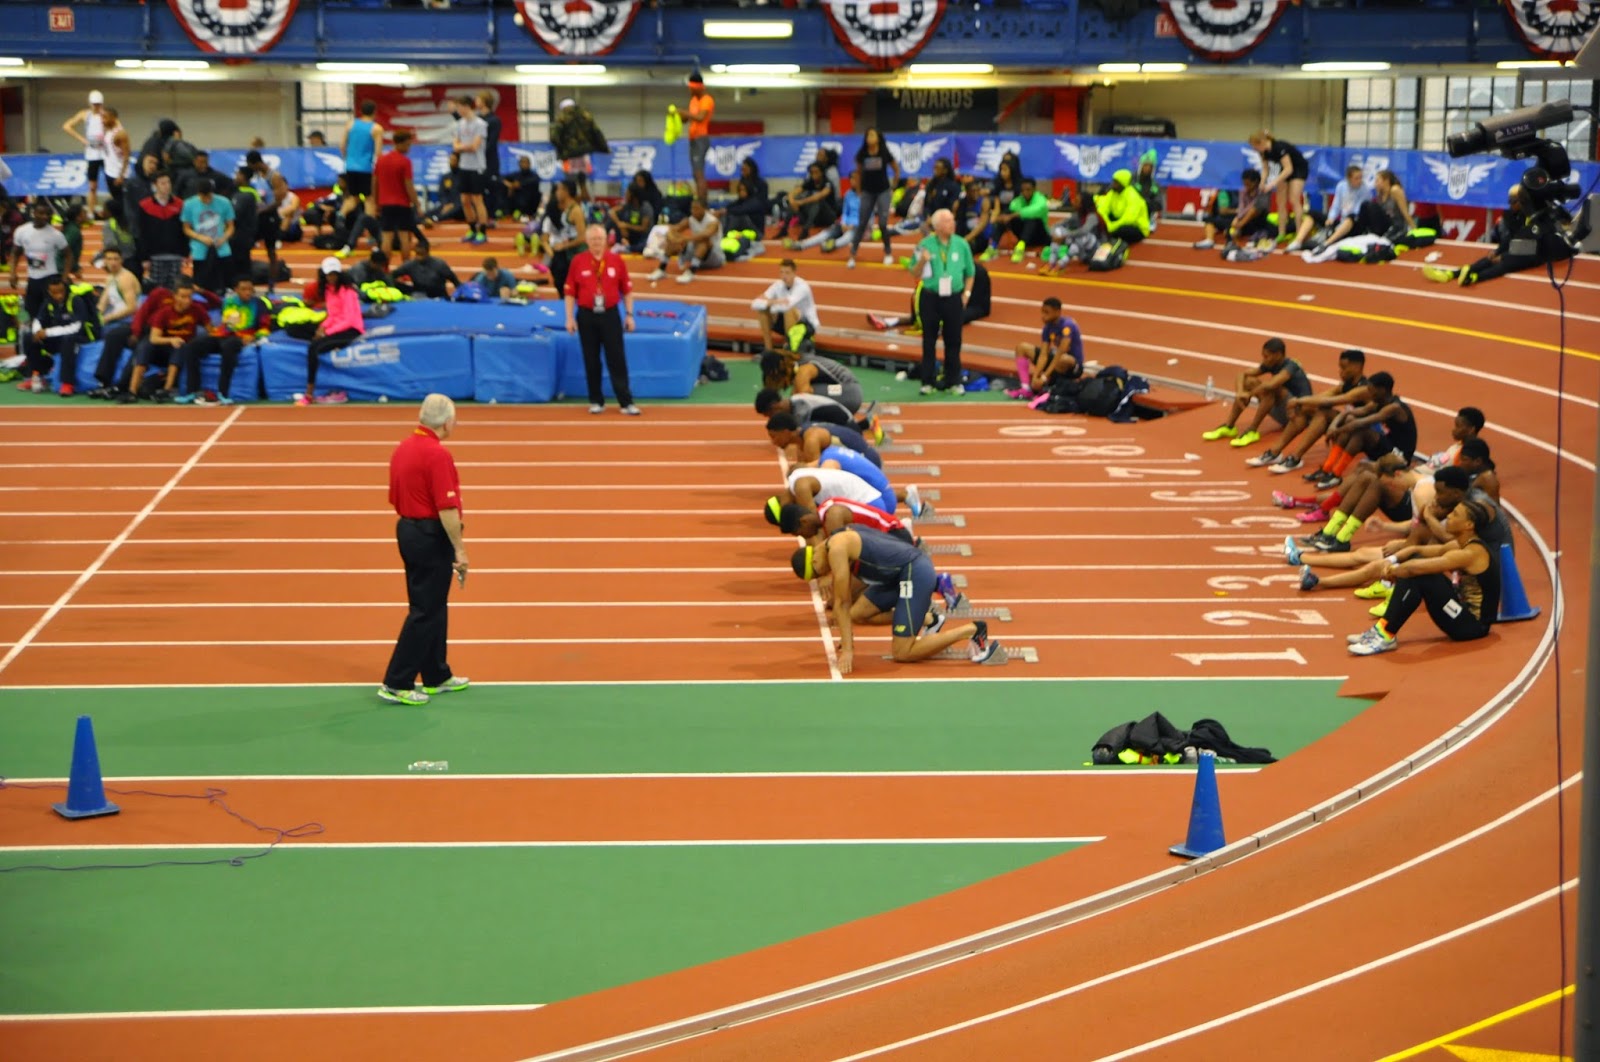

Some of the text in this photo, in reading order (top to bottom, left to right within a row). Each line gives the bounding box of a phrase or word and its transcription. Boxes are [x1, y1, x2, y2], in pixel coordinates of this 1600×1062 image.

[900, 88, 974, 109] AWARDS
[1156, 146, 1208, 180] NB
[36, 160, 88, 189] NB
[998, 425, 1087, 437] 9
[1051, 445, 1145, 457] 8
[1104, 466, 1202, 479] 7
[1150, 489, 1252, 502] 6
[1192, 516, 1302, 529] 5
[1206, 574, 1303, 590] 3
[1202, 609, 1329, 627] 2
[1171, 648, 1308, 666] 1
